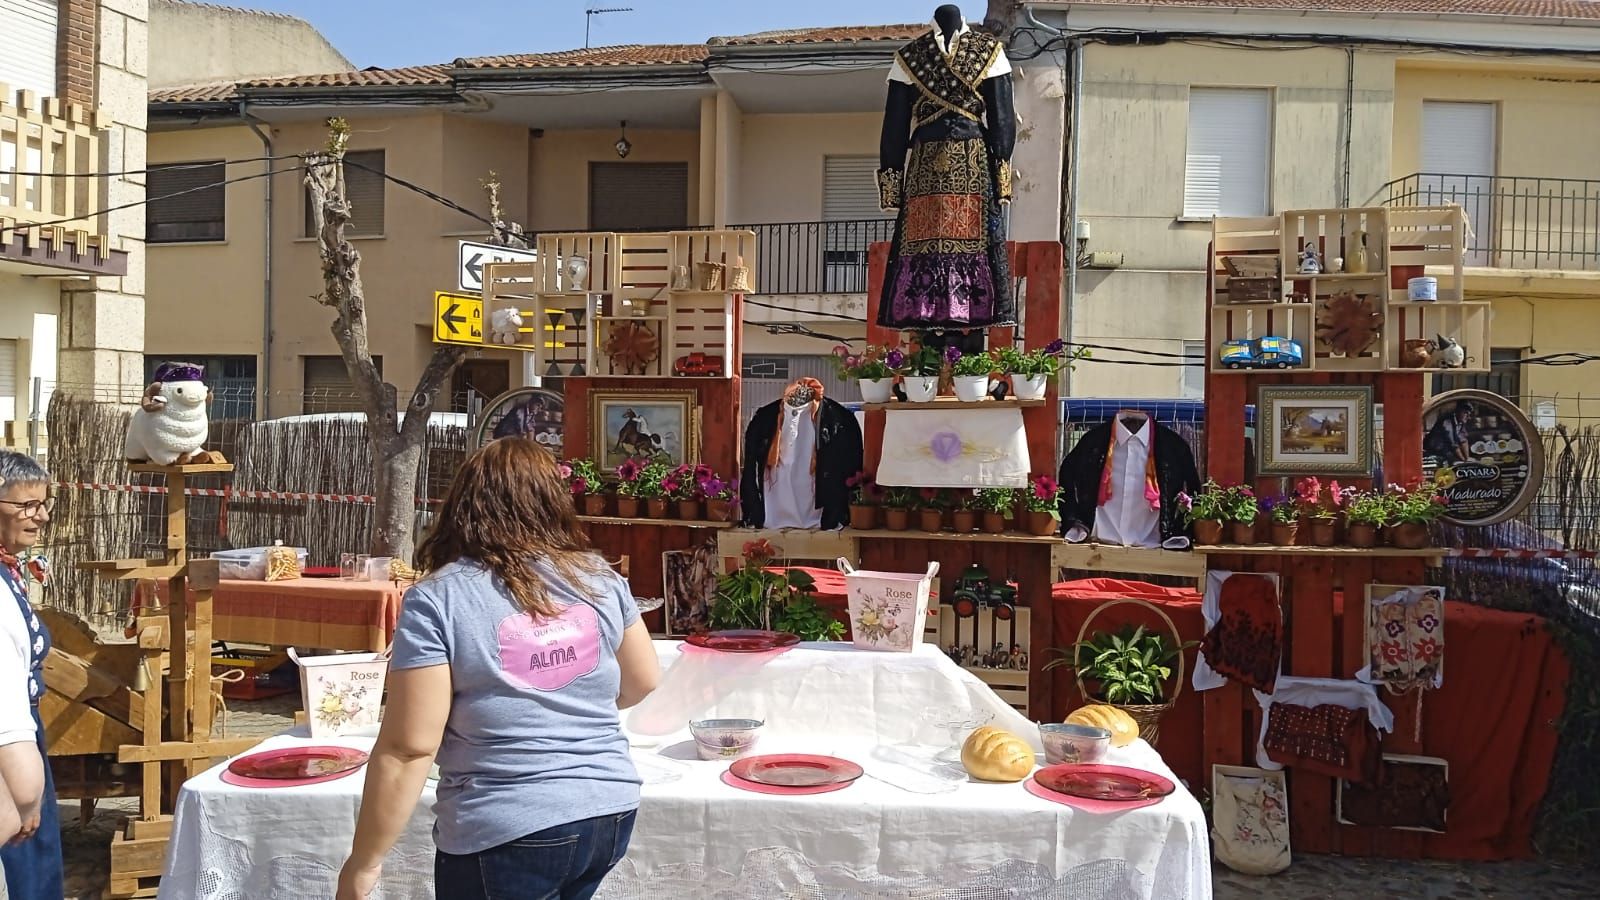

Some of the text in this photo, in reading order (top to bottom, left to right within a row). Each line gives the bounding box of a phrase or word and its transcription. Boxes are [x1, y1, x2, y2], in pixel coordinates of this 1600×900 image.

[1456, 467, 1497, 477] CYNARA
[1443, 486, 1502, 500] Madurado
[885, 587, 913, 599] Rose
[529, 645, 578, 671] ALMA
[350, 671, 380, 681] Rose
